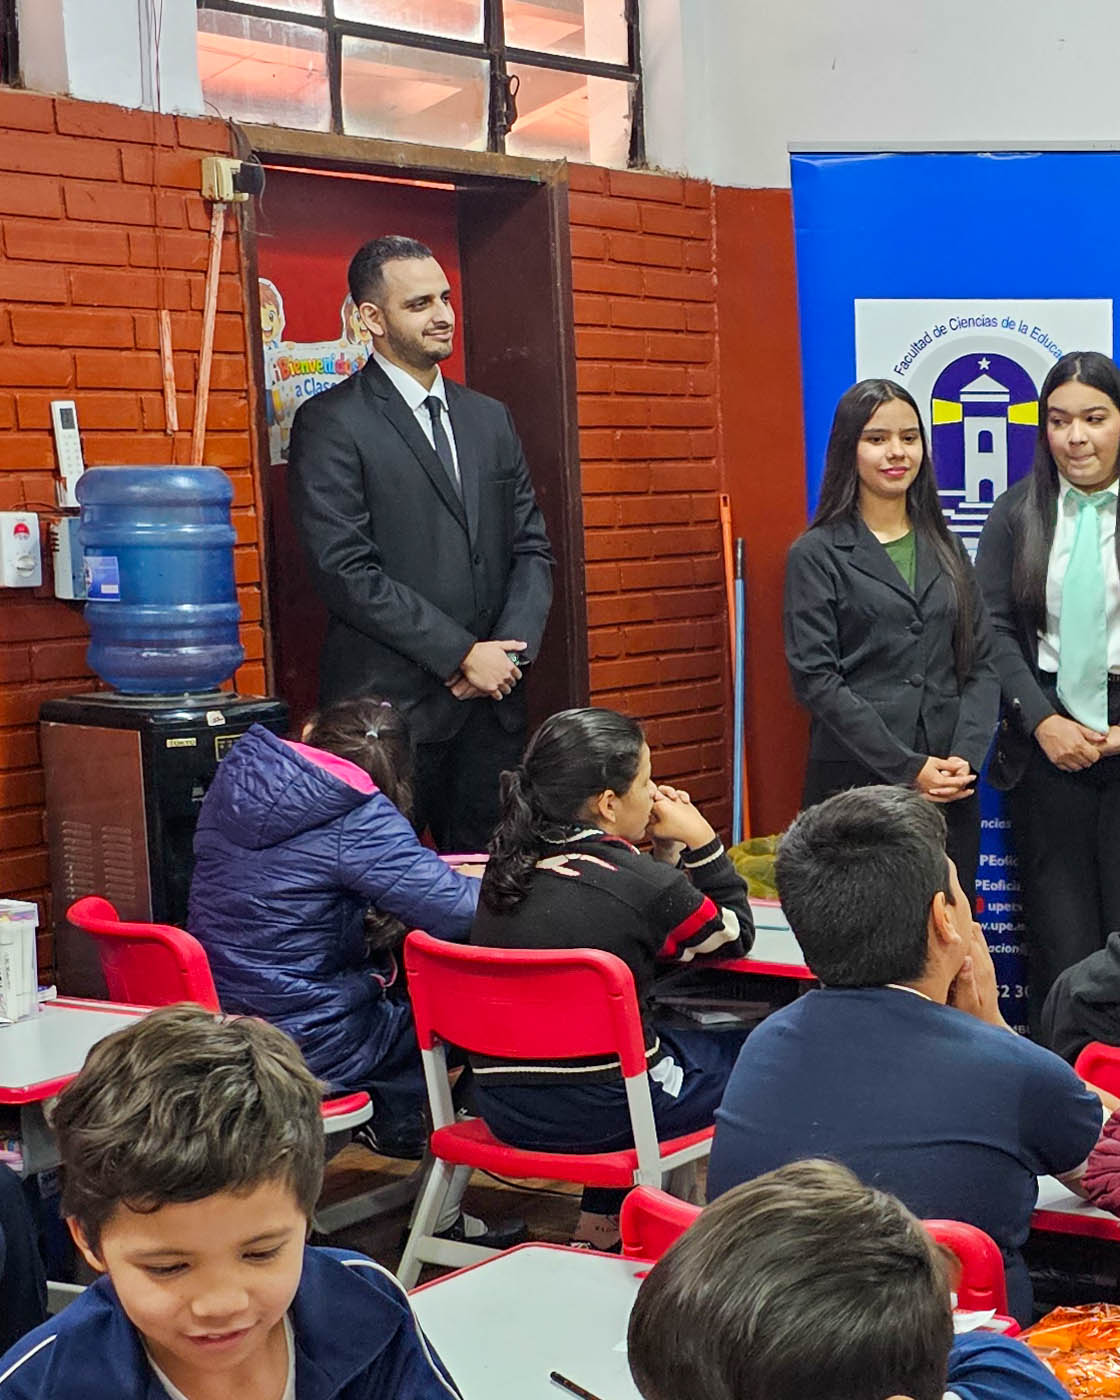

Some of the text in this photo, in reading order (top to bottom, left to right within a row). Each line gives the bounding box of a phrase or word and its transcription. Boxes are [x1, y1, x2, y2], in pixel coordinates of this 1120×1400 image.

[894, 331, 933, 376] Facultad
[933, 324, 947, 338] de
[949, 314, 998, 331] Ciencias
[1001, 316, 1015, 330] de
[1018, 320, 1028, 335] la
